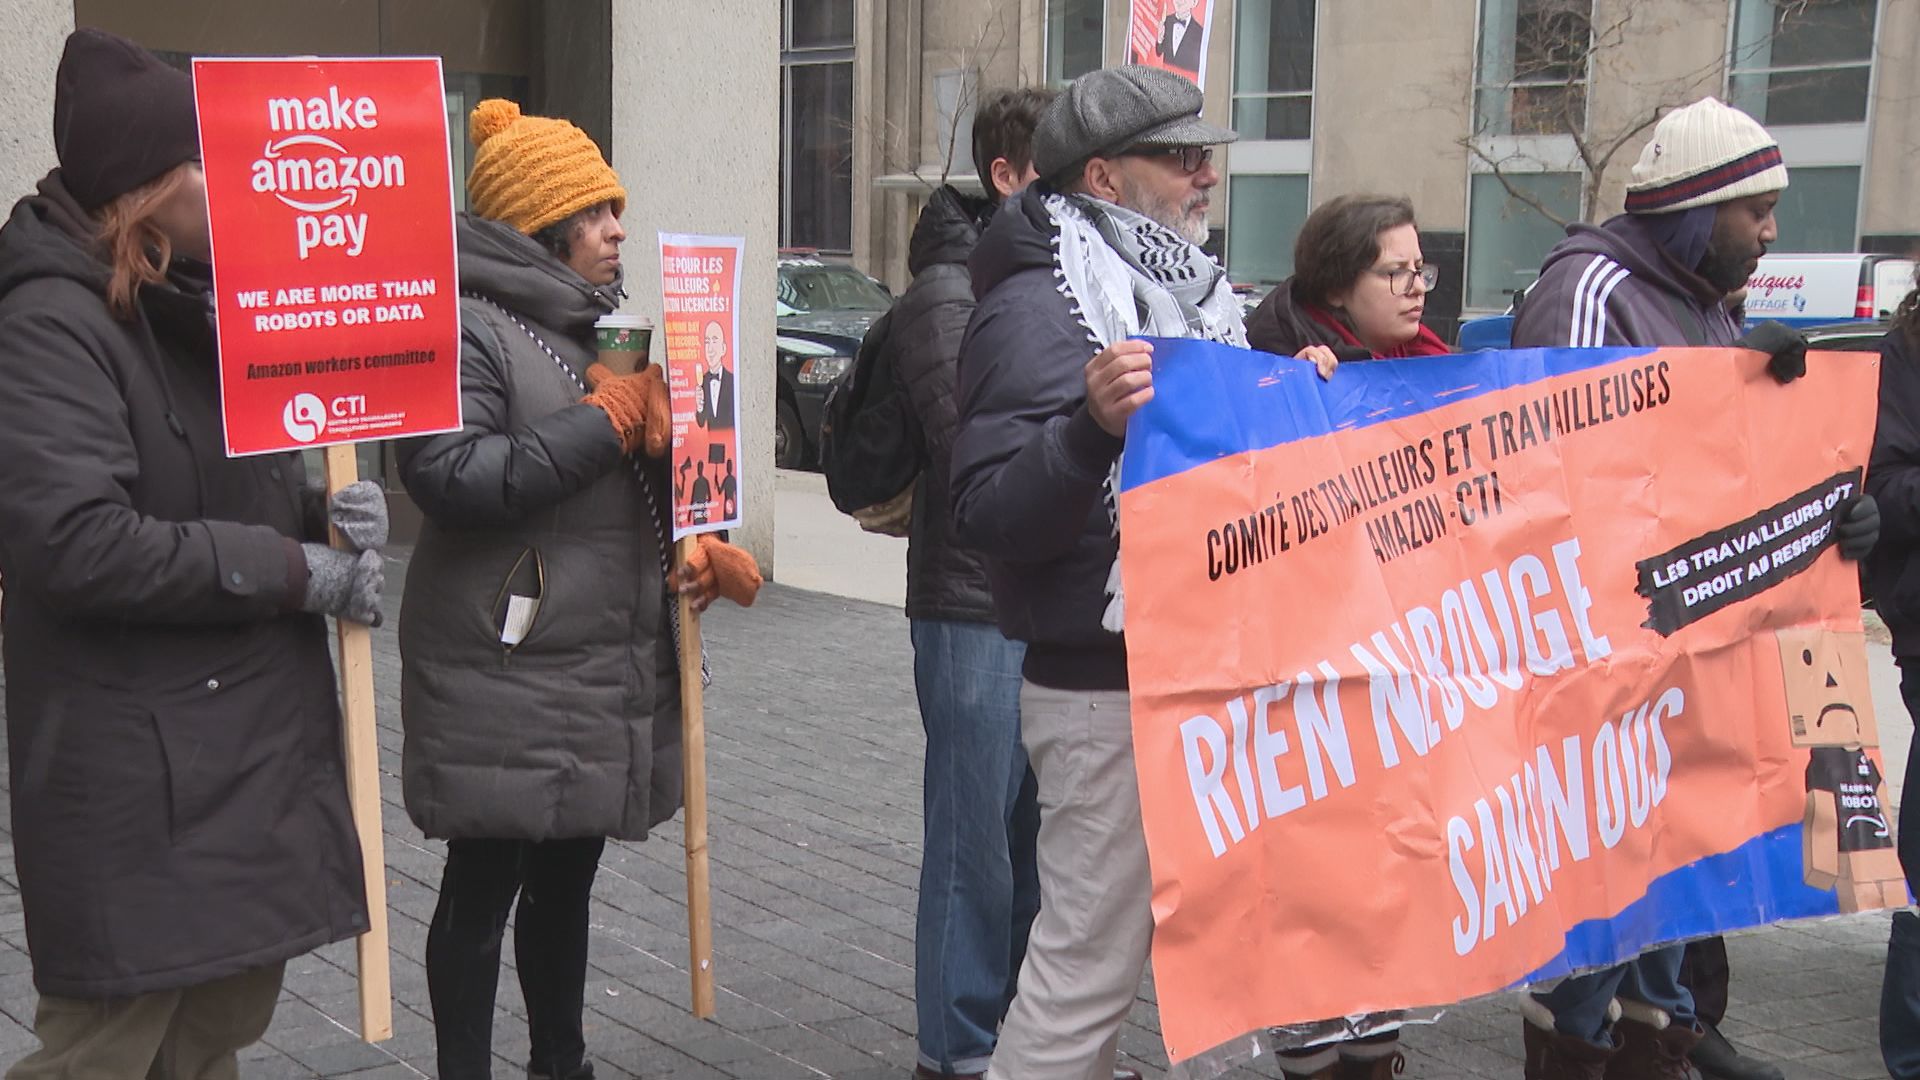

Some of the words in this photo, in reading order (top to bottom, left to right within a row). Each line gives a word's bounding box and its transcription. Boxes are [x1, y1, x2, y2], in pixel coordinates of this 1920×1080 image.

[268, 85, 378, 132] make
[251, 153, 405, 194] amazon
[296, 212, 368, 260] pay
[702, 256, 724, 274] LES
[1747, 273, 1804, 297] niques
[237, 291, 269, 309] WE
[275, 287, 316, 307] ARE
[320, 283, 378, 304] MORE
[382, 279, 437, 299] THAN
[1745, 299, 1788, 309] UFFAGE
[255, 311, 338, 332] ROBOTS
[342, 307, 371, 326] OR
[375, 303, 425, 323] DATA
[246, 358, 302, 381] Amazon
[304, 354, 362, 375] workers
[364, 348, 437, 370] committee
[332, 394, 366, 417] CTI
[1206, 491, 1291, 582] COMITÉ
[1291, 488, 1329, 544] DES
[1442, 423, 1473, 477] ET
[1481, 361, 1672, 461] TRAVAILLEUSES
[1365, 493, 1448, 565] AMAZON
[1652, 559, 1690, 589] LES
[1690, 497, 1824, 572] TRAVAILLEURS
[1682, 567, 1744, 608] DROIT
[1747, 554, 1770, 582] AU
[1179, 660, 1357, 859] RIEN
[1404, 536, 1613, 732] BOUGE
[1446, 760, 1554, 957] SANS
[1535, 686, 1685, 872] NOUS
